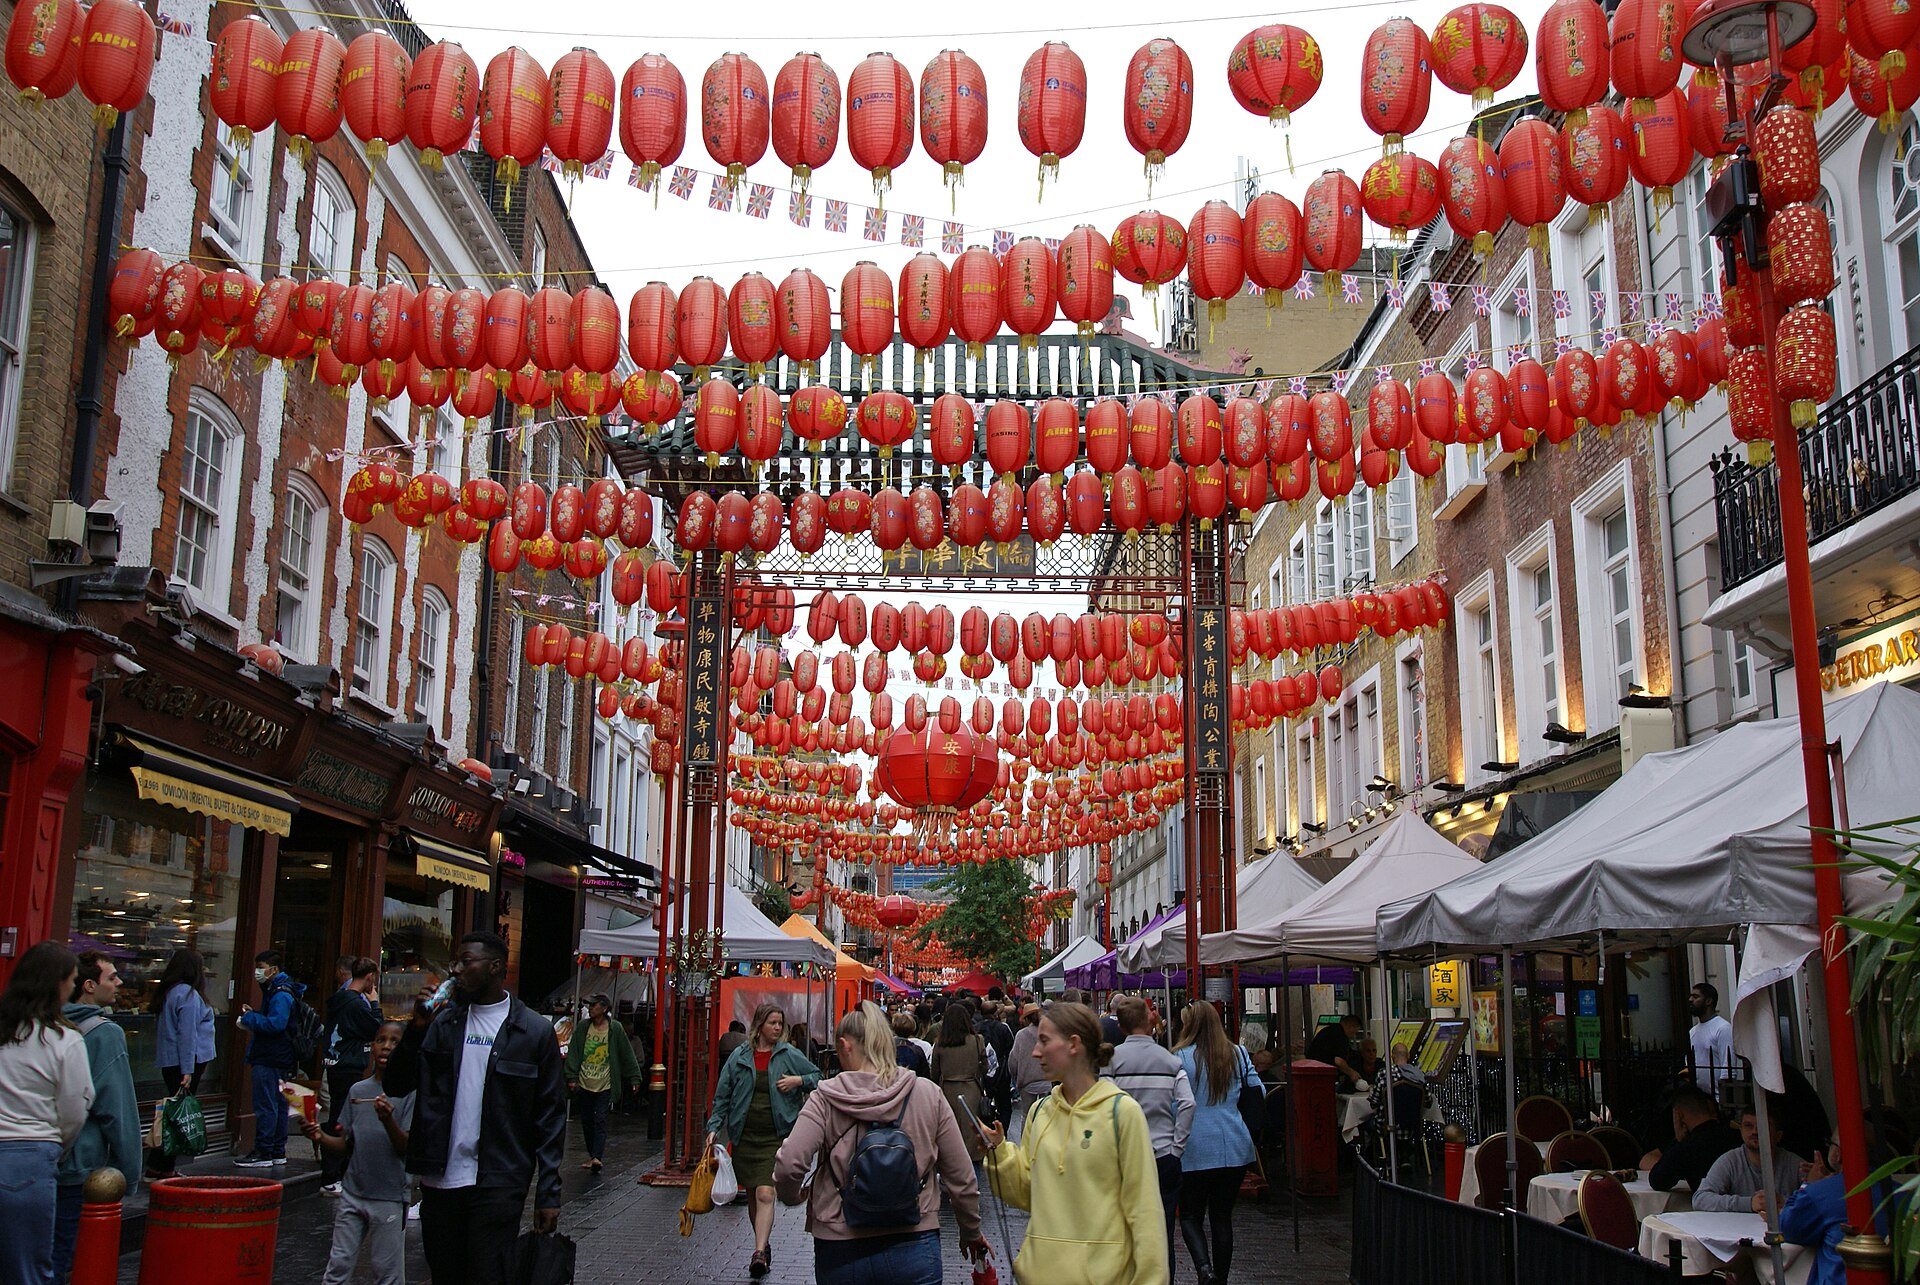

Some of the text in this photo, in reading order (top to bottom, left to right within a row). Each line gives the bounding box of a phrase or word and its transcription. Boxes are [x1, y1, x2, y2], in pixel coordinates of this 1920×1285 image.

[90, 32, 137, 48] ABP
[1566, 17, 1579, 59] 財源廣進
[709, 405, 737, 417] ABP
[1045, 427, 1073, 437] ABP
[1090, 427, 1117, 437] ABP
[1132, 424, 1157, 434] ABP
[1362, 448, 1382, 457] CASIN
[1820, 628, 1920, 692] GERRAR
[693, 602, 716, 761] 埠物康民敏寺鐘
[195, 692, 289, 751] KOWLOON
[943, 739, 961, 775] 安康
[162, 783, 189, 801] KOWLOON
[213, 798, 230, 814] BUFFET
[408, 786, 458, 820] KOWLOON
[582, 878, 615, 887] AUTHENTIC
[1432, 961, 1454, 1003] 酒家
